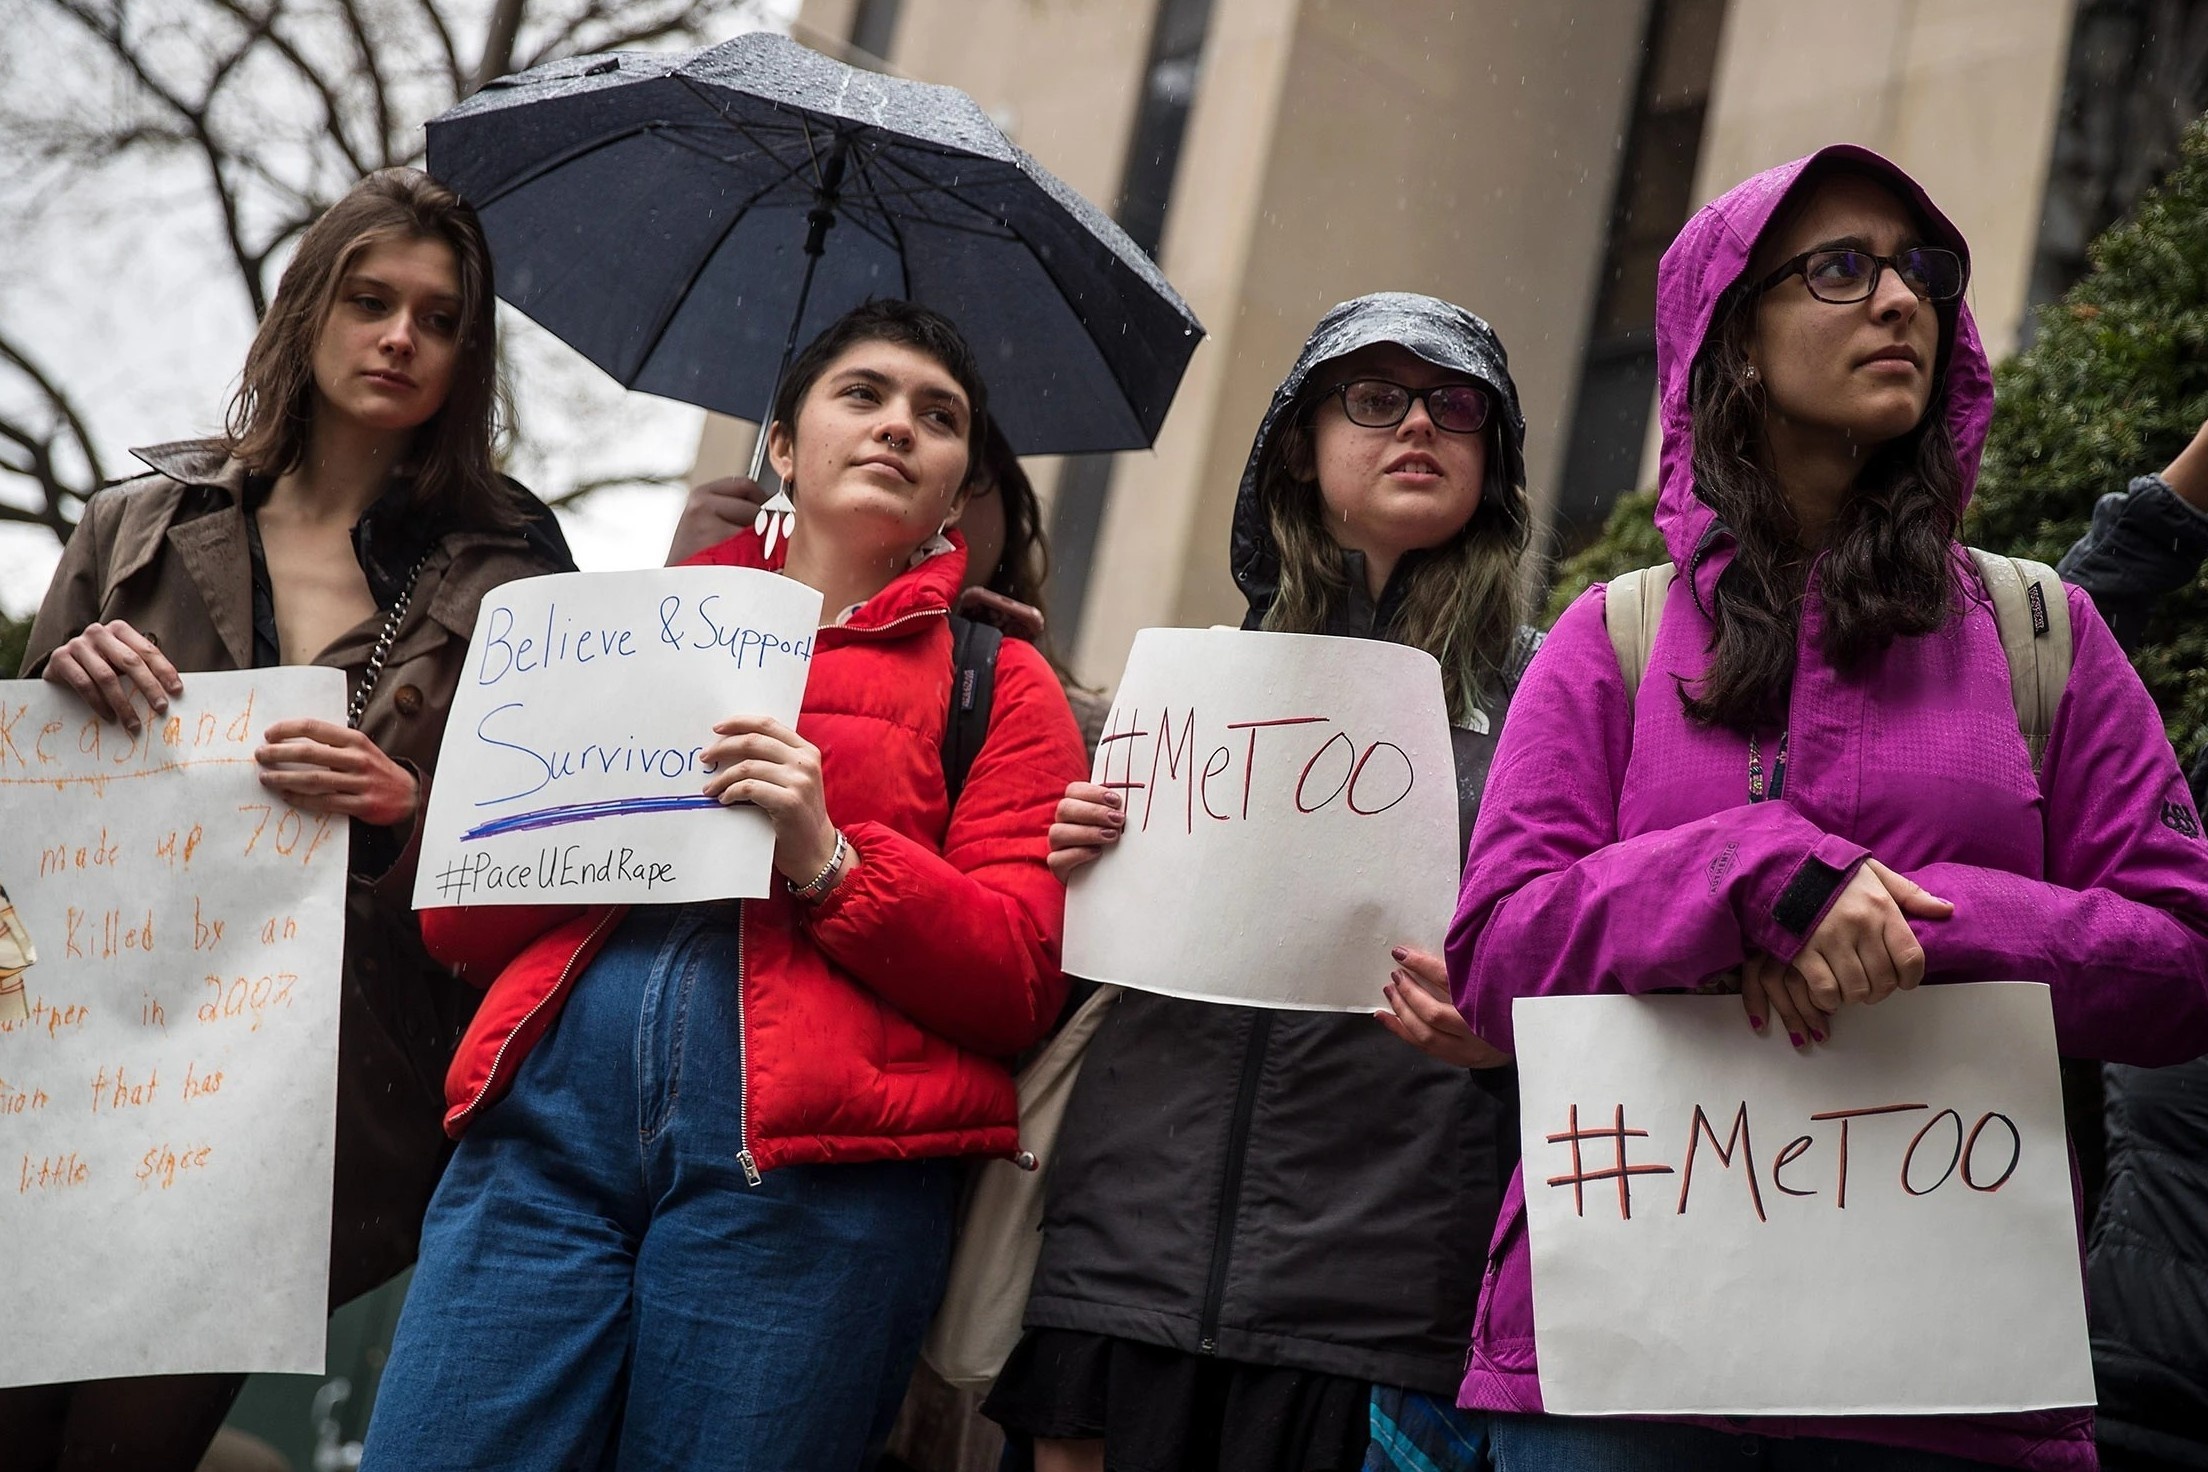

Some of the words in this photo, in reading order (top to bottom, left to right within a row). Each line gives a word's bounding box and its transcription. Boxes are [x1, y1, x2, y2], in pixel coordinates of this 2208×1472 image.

[479, 603, 636, 686] Believe
[659, 595, 684, 651] &
[693, 595, 813, 669] Support
[40, 825, 119, 877] made
[435, 844, 678, 905] #PaceUEndRape
[1710, 843, 1736, 893] AUTHENTIC
[65, 906, 154, 960] Killed
[193, 896, 226, 951] by
[261, 915, 298, 945] an
[142, 989, 168, 1037] in
[90, 1065, 159, 1113] that
[183, 1061, 225, 1100] has
[20, 1151, 90, 1194] little
